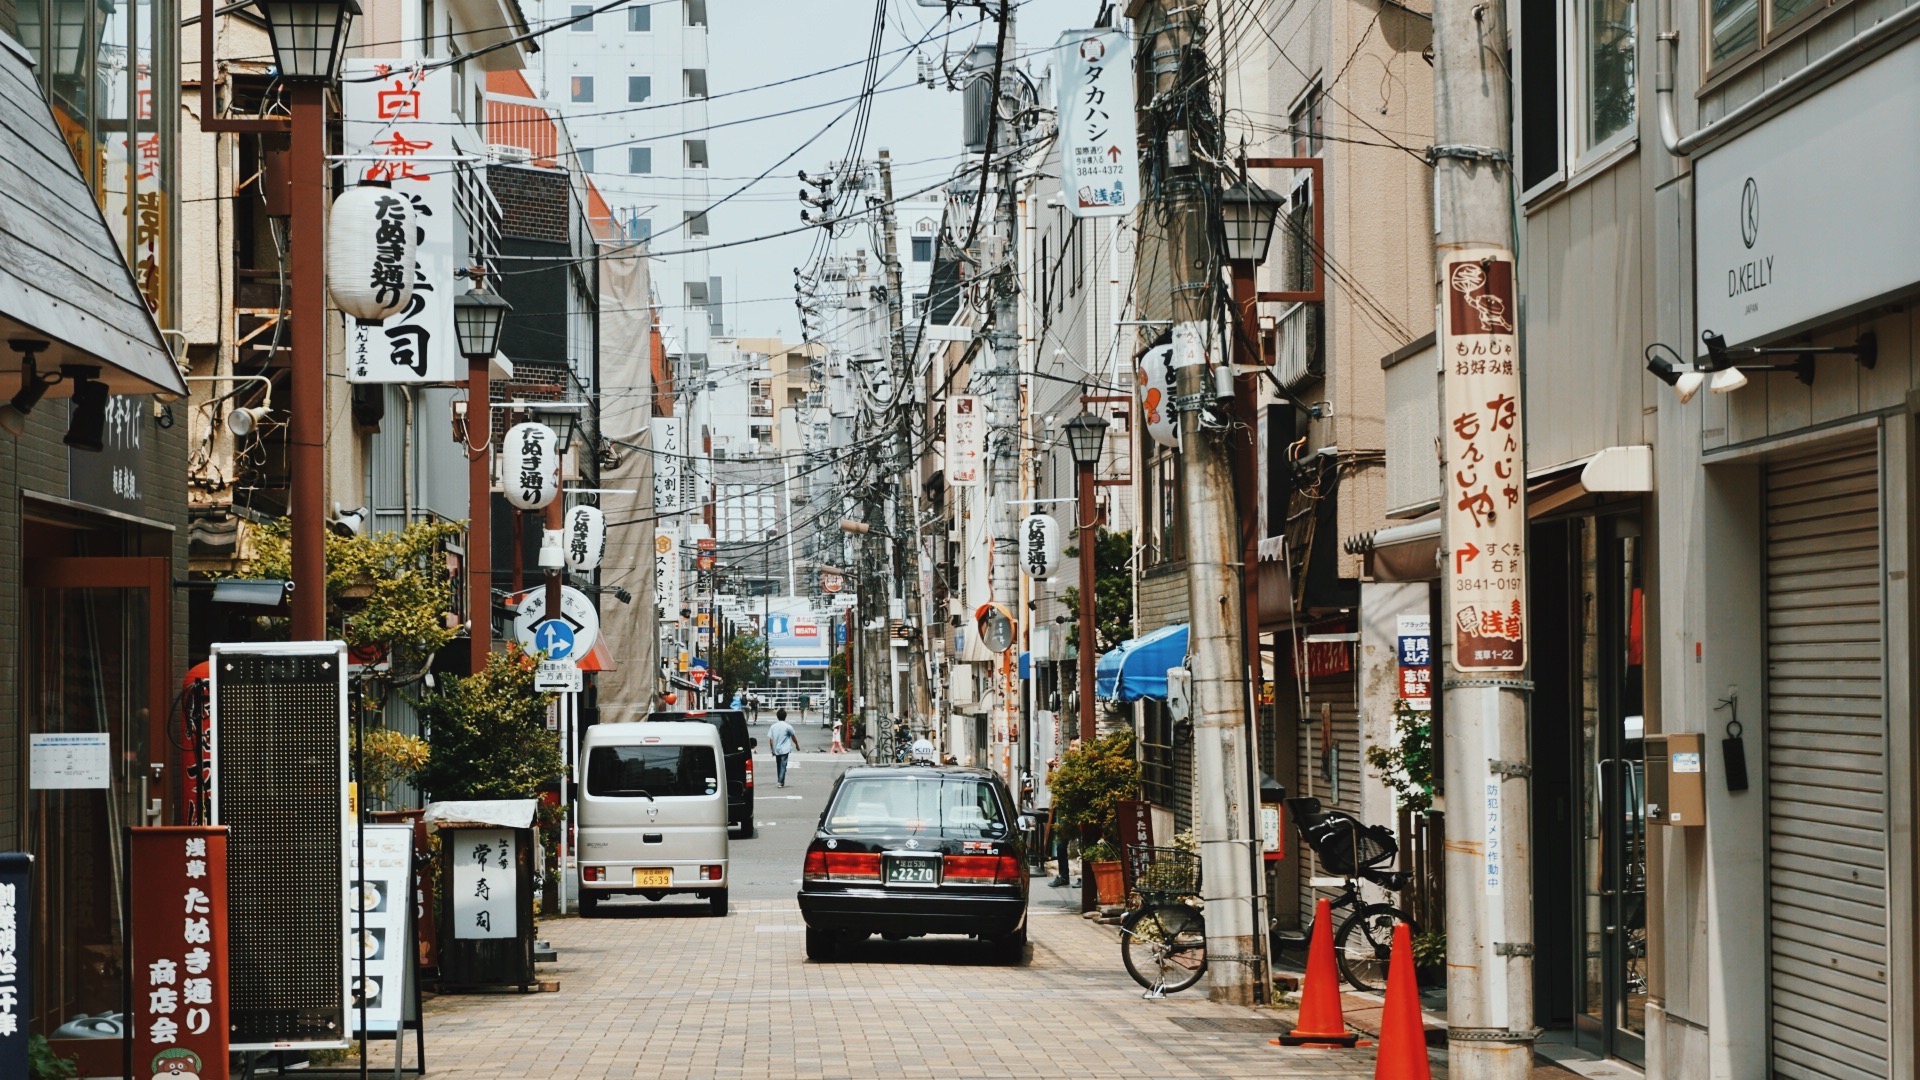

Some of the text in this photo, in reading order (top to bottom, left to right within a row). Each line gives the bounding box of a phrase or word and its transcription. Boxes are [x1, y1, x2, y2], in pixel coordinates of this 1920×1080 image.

[1084, 66, 1109, 142] タカハシ
[366, 80, 433, 181] 白鹿
[1075, 146, 1104, 155] 国際通り
[1077, 165, 1123, 176] 3844-4372
[1094, 188, 1122, 204] 浅草
[370, 195, 406, 310] たぬき通り
[1728, 254, 1774, 298] D.KELLY
[1744, 302, 1759, 316] JAPAN
[1456, 339, 1512, 356] もんじゃ
[1455, 359, 1513, 376] お好み焼
[1486, 393, 1519, 510] なんじゃ
[520, 427, 545, 504] たぬき通り
[571, 509, 591, 565] たぬき通り
[1028, 518, 1048, 576] たぬき通り
[1486, 543, 1520, 556] すぐ先
[1491, 560, 1518, 573] 右折
[656, 556, 667, 619] スタミナ屋
[1456, 579, 1521, 591] 3841-0197
[1481, 609, 1521, 639] 浅草
[1403, 638, 1429, 651] 吉良
[1474, 650, 1513, 660] 浅草1-22
[1404, 651, 1429, 662] よし子
[1404, 670, 1430, 682] 志位
[1404, 683, 1427, 693] 和夫
[1487, 785, 1499, 889] 防犯カメラ作動中
[185, 838, 206, 879] 浅草
[498, 838, 510, 870] 江戸前
[643, 876, 669, 885] 65-39
[898, 868, 933, 880] 22-70
[472, 844, 492, 933] 常寿司
[184, 887, 212, 1035] たぬき通り
[149, 959, 178, 1044] 商店会
